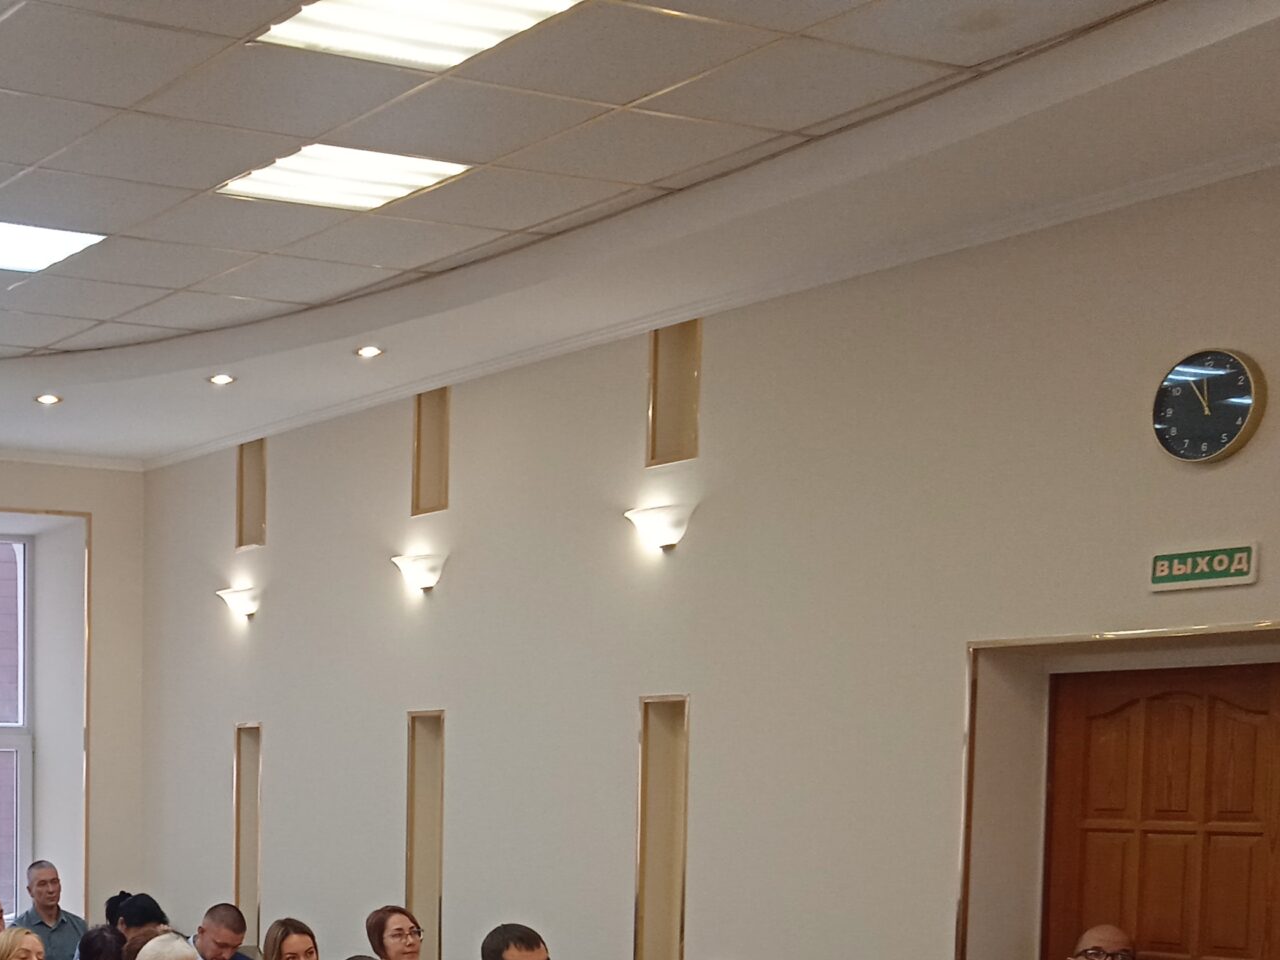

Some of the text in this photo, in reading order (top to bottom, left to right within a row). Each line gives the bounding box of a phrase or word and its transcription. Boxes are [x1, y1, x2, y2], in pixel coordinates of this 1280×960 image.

[1237, 375, 1245, 385] 2
[1171, 387, 1182, 396] 10
[1165, 408, 1173, 418] 9
[1235, 417, 1242, 425] 4
[1170, 427, 1177, 436] 8
[1221, 433, 1228, 443] 5
[1183, 439, 1190, 448] 7
[1201, 442, 1208, 451] 6
[1154, 552, 1249, 578] ВЫХОД
